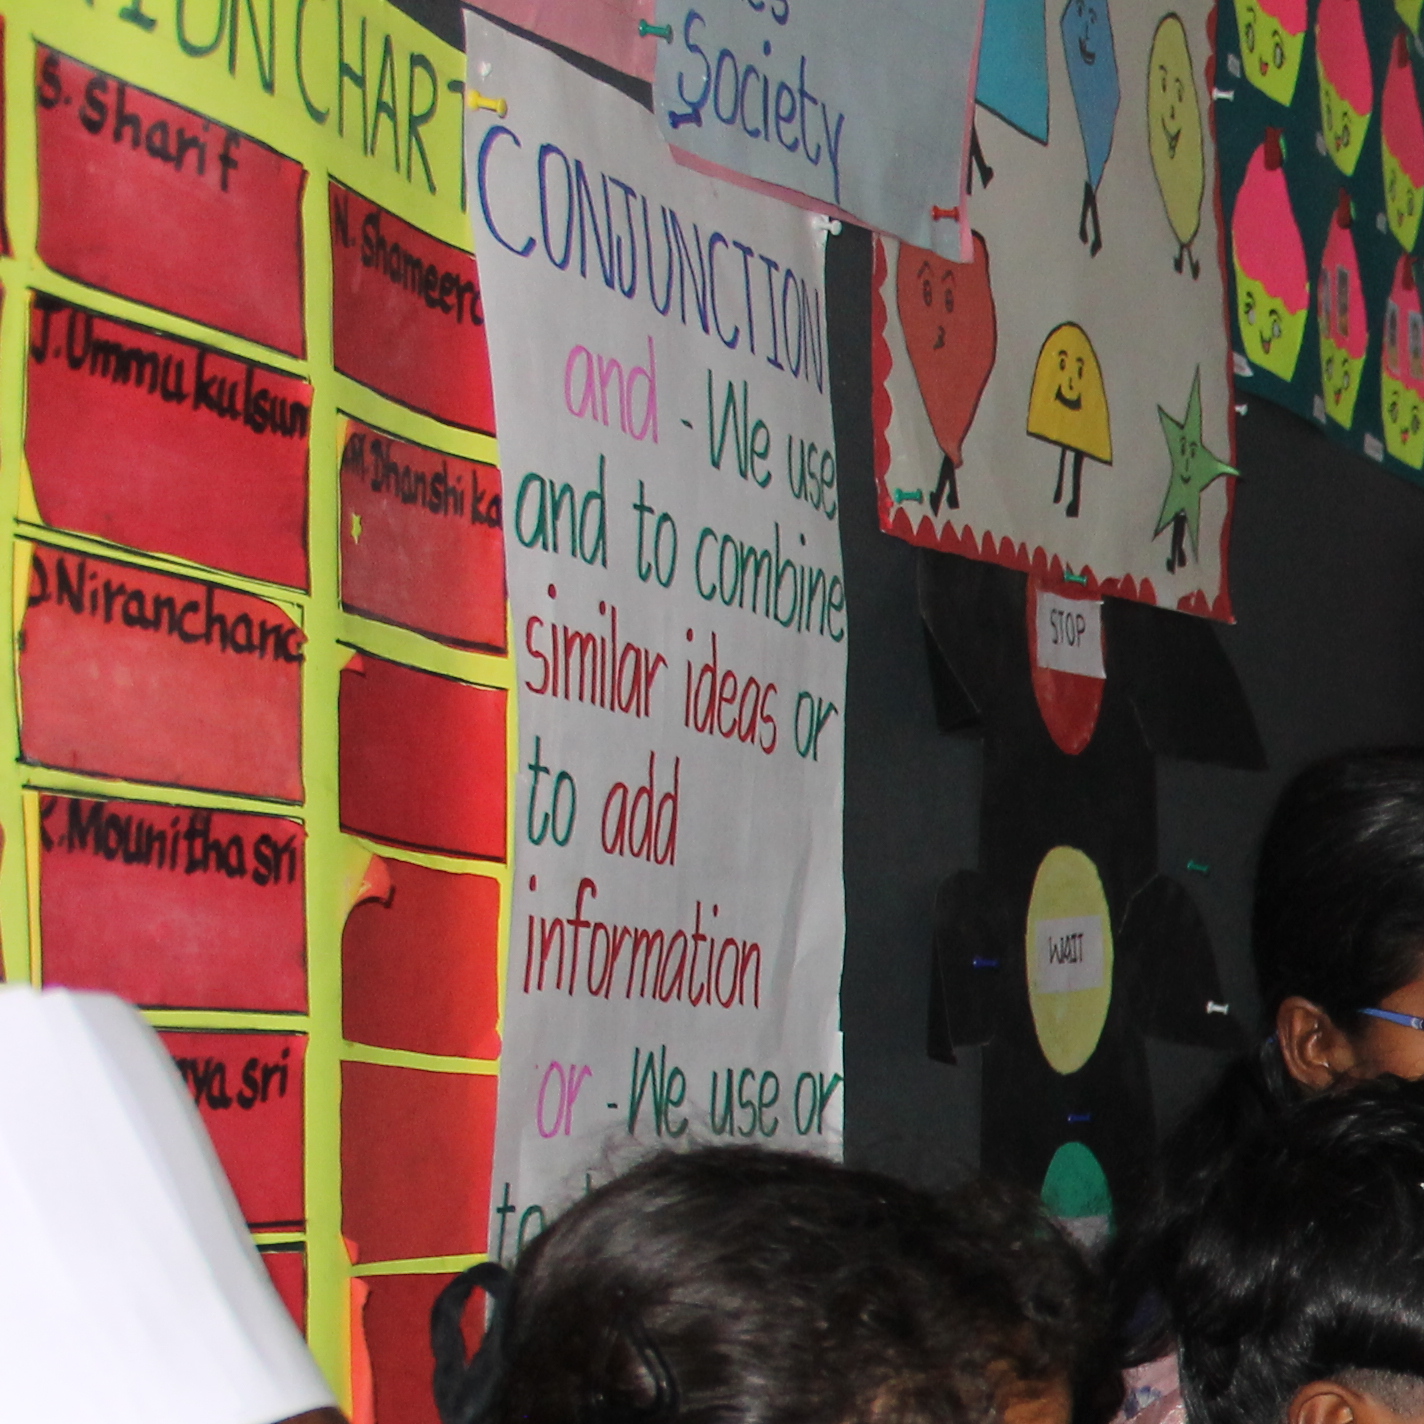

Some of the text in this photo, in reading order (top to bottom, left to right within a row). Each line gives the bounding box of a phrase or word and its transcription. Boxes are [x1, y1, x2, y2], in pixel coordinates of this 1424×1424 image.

[677, 8, 845, 205] Society
[477, 124, 825, 394] CONJUNCTION
[563, 335, 658, 444] and
[706, 368, 773, 488] We
[787, 436, 838, 520] use
[514, 454, 845, 643] and to combine
[1049, 608, 1087, 648] STOP
[524, 583, 839, 763] similar ideas or
[527, 735, 681, 867] to add
[522, 874, 763, 1010] information
[535, 1063, 593, 1139] or
[627, 1044, 689, 1137] We
[709, 1065, 779, 1137] use
[794, 1066, 844, 1137] or
